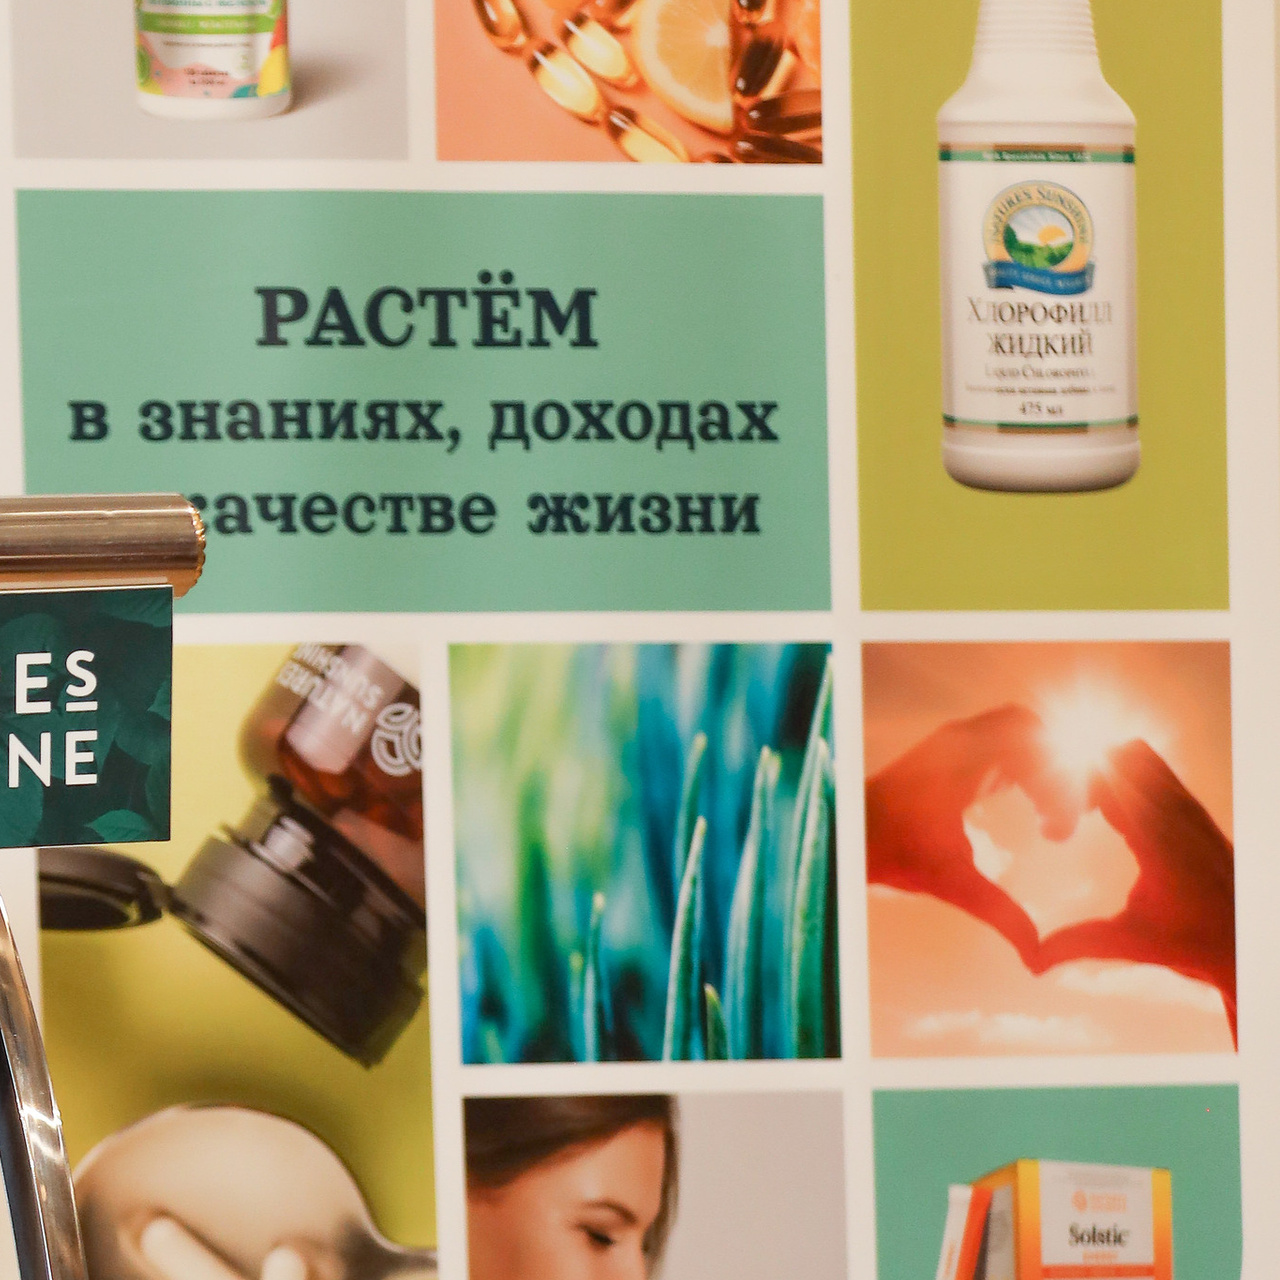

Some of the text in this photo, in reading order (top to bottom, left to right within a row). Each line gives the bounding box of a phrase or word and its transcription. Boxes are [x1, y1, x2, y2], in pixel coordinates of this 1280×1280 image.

[254, 269, 600, 348] РАСТЁМ
[68, 399, 780, 453] в знаниях, доходах
[526, 491, 762, 536] жизни
